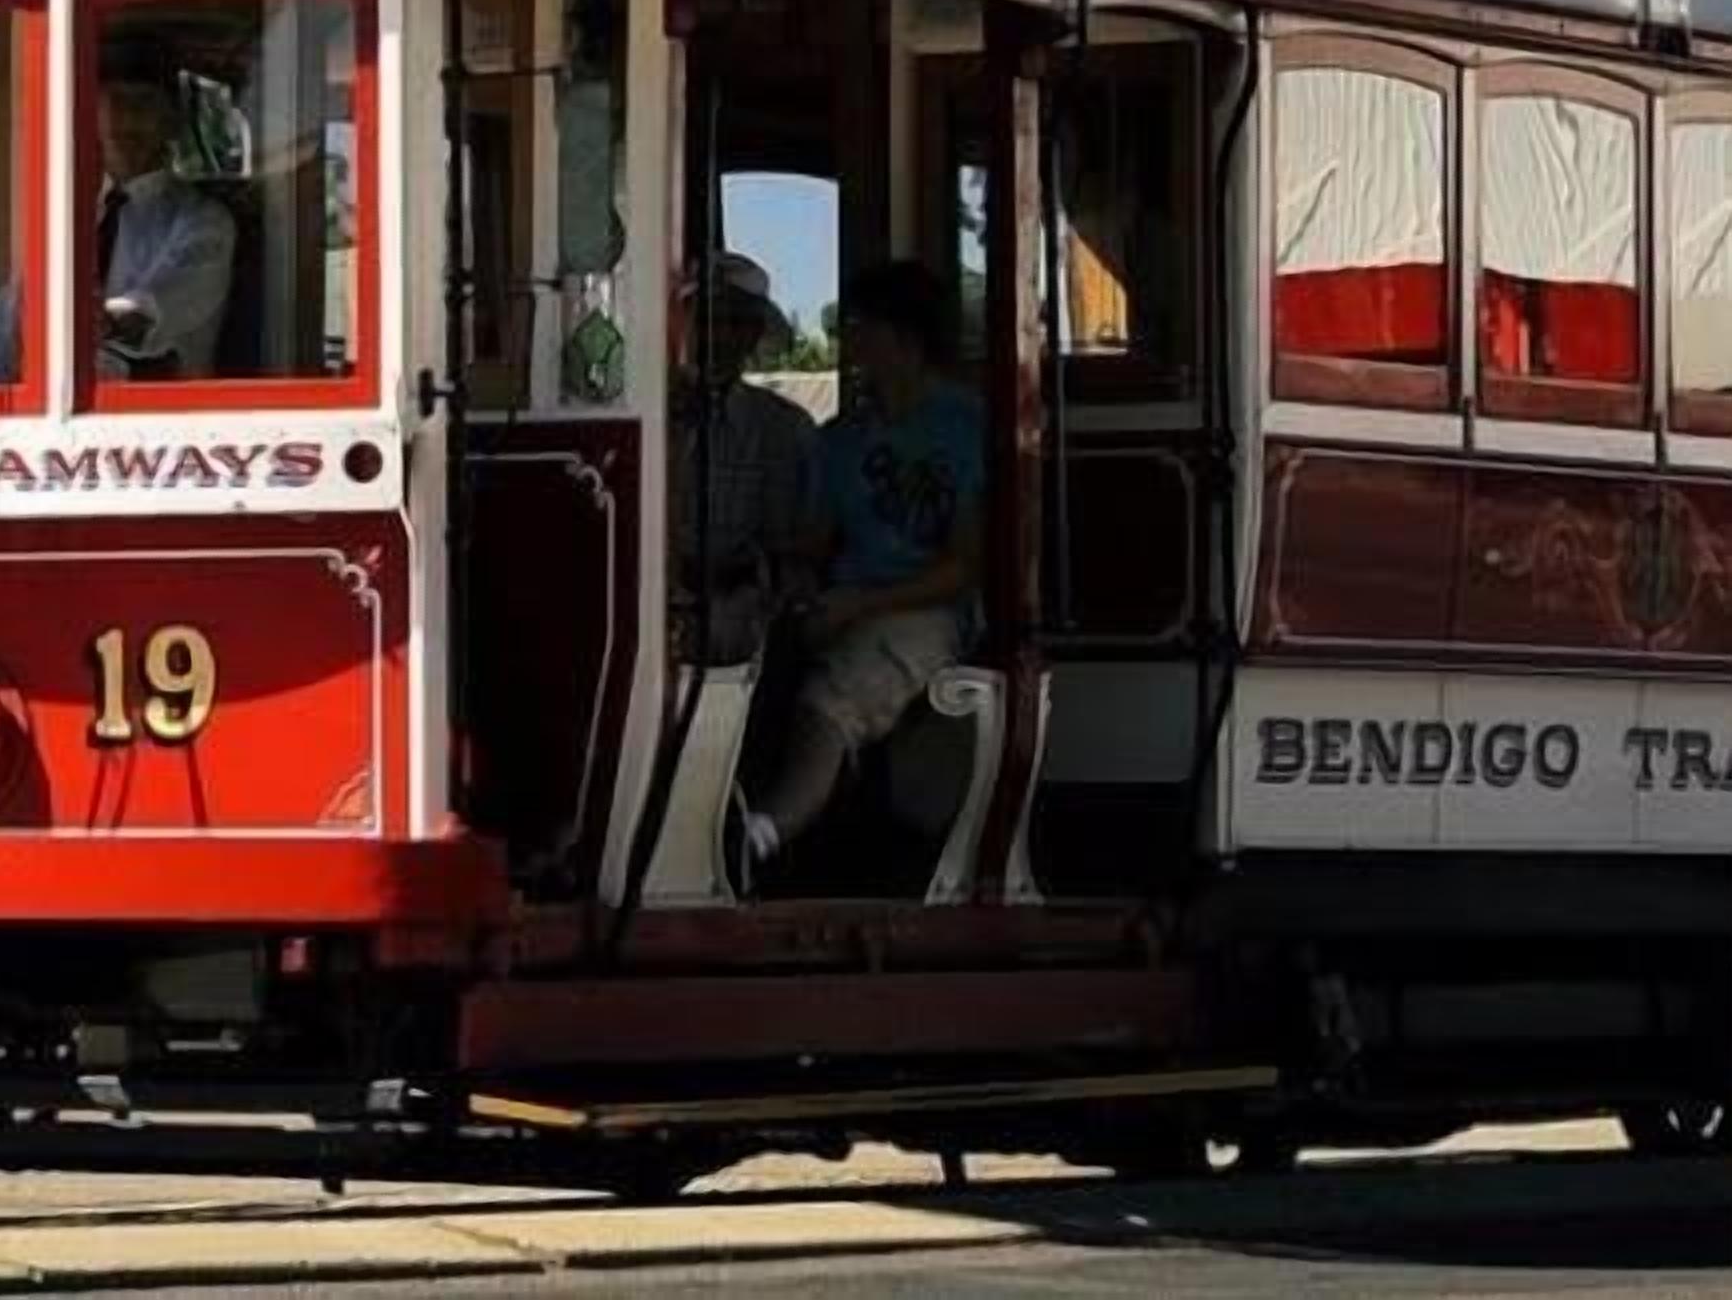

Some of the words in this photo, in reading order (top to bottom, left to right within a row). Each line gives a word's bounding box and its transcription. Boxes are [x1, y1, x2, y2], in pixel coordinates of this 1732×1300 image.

[88, 625, 217, 742] 19
[1255, 717, 1581, 788] BENDIGO
[1622, 727, 1732, 791] TR
